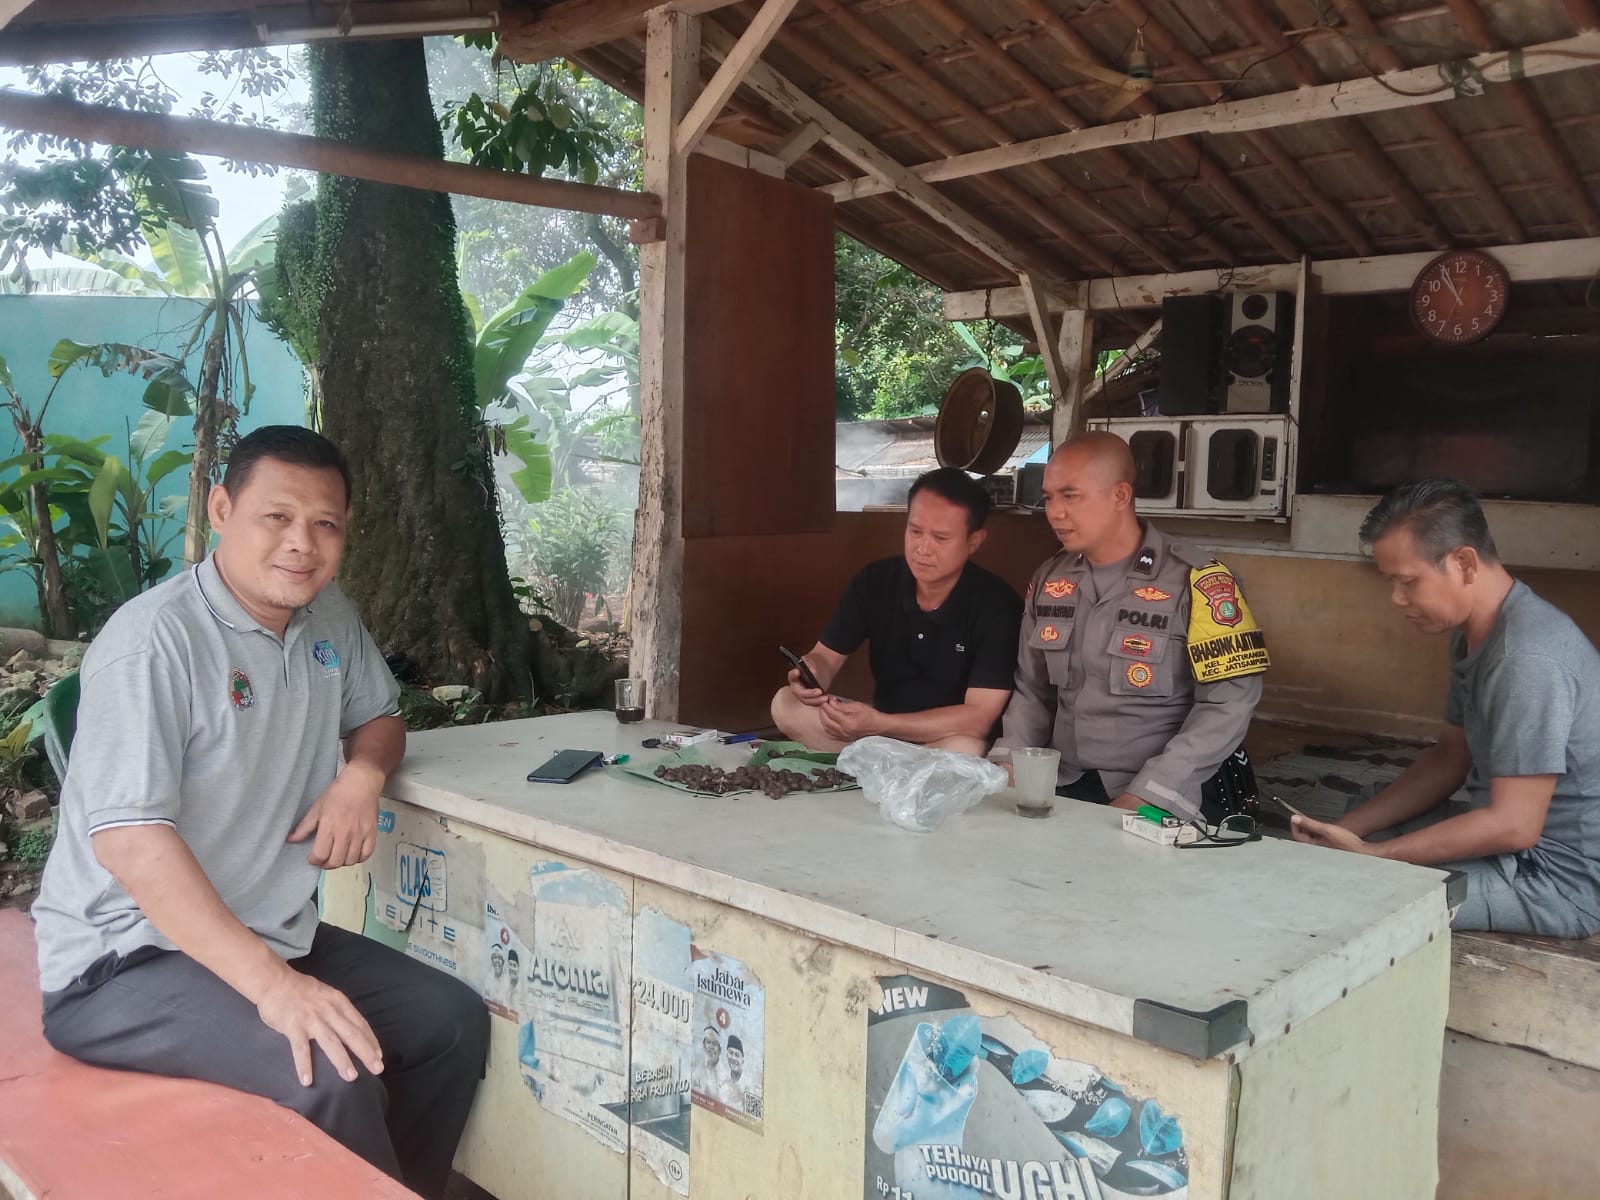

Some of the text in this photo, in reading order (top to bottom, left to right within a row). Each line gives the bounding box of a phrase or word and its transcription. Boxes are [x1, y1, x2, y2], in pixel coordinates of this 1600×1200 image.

[1455, 261, 1467, 274] 12
[1475, 264, 1480, 277] 1
[1429, 280, 1441, 292] 10
[1485, 276, 1494, 288] 2
[1422, 295, 1431, 307] 9
[1490, 290, 1498, 302] 3
[1428, 310, 1437, 322] 8
[1484, 305, 1493, 316] 4
[1438, 320, 1446, 332] 7
[1454, 324, 1463, 336] 6
[1472, 318, 1480, 330] 5
[1118, 609, 1169, 630] POLRI
[711, 967, 744, 991] Jabar
[697, 973, 751, 1006] Istimewa
[637, 979, 690, 1023] 24.000
[878, 986, 929, 1016] NEW
[719, 1012, 727, 1025] 4
[876, 1175, 889, 1196] Rp
